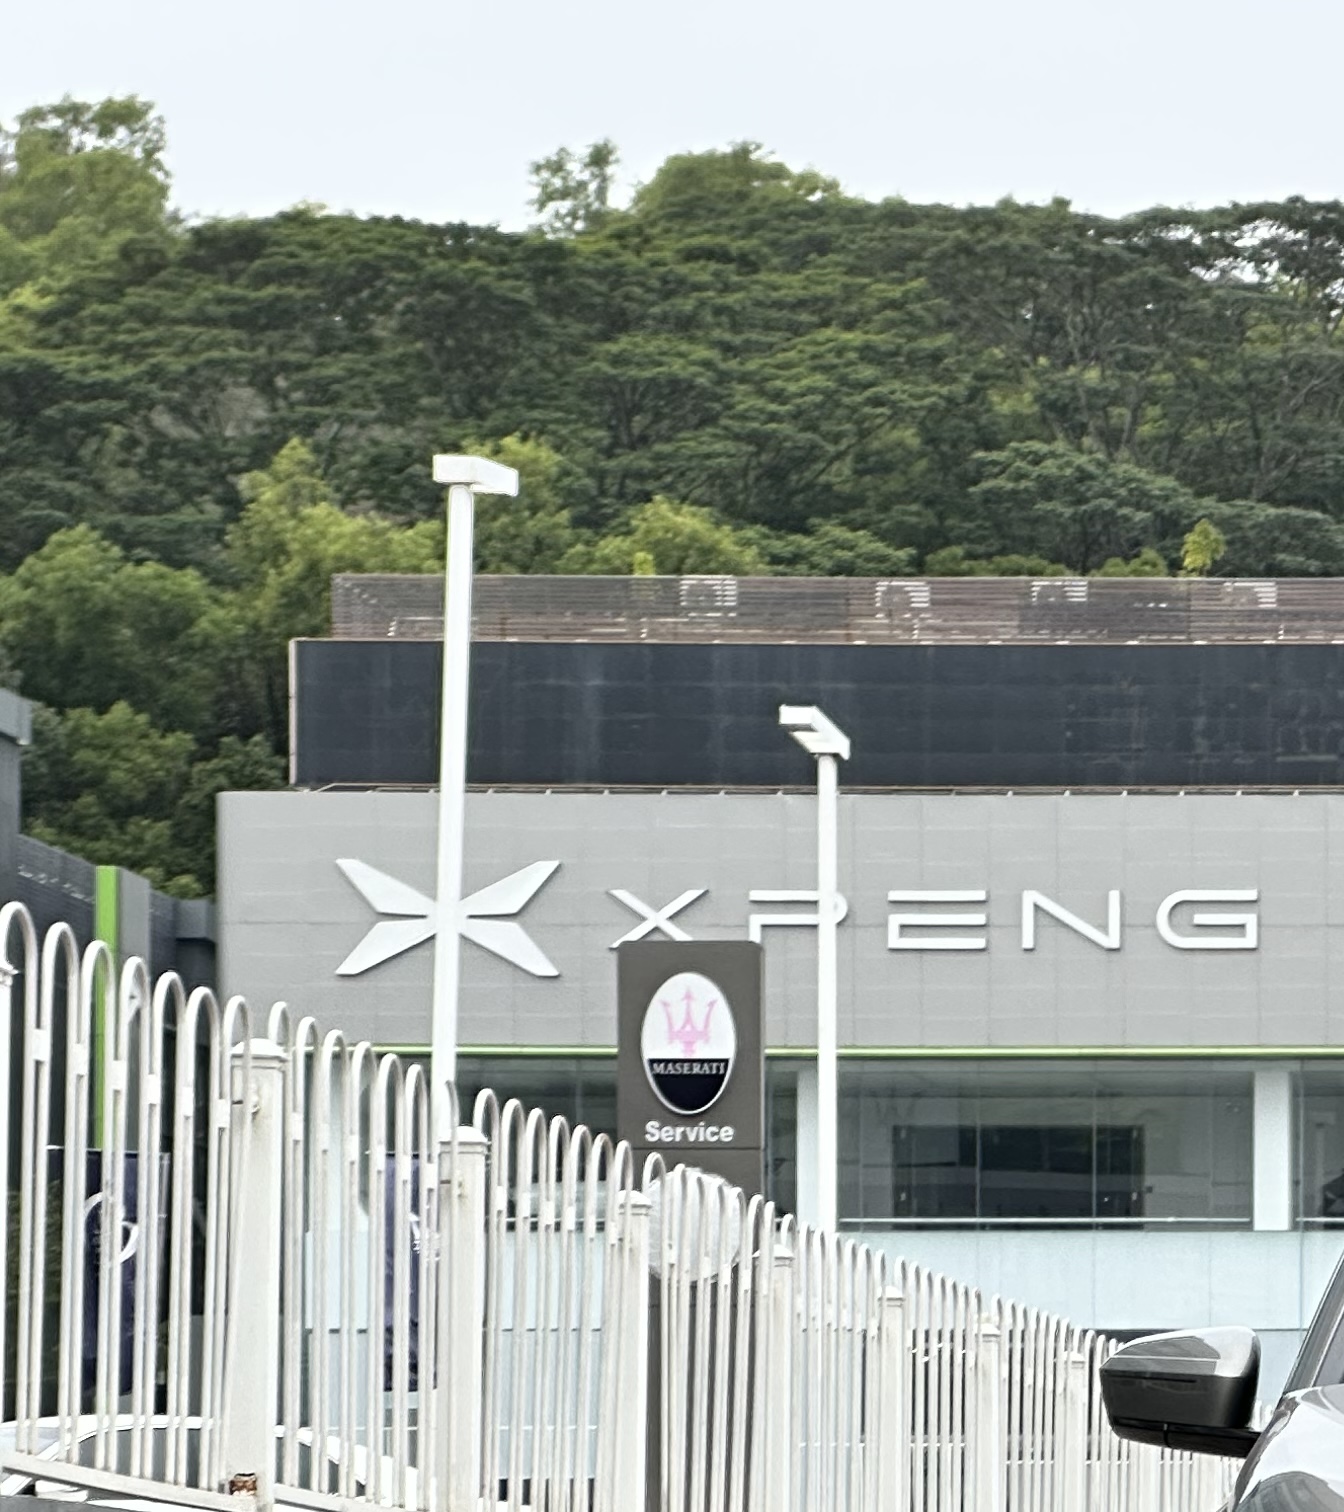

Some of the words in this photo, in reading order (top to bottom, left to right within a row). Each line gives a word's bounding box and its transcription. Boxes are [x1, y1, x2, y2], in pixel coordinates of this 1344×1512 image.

[607, 888, 1258, 951] XPENG
[651, 1061, 725, 1075] MASERATI
[644, 1120, 735, 1142] Service
